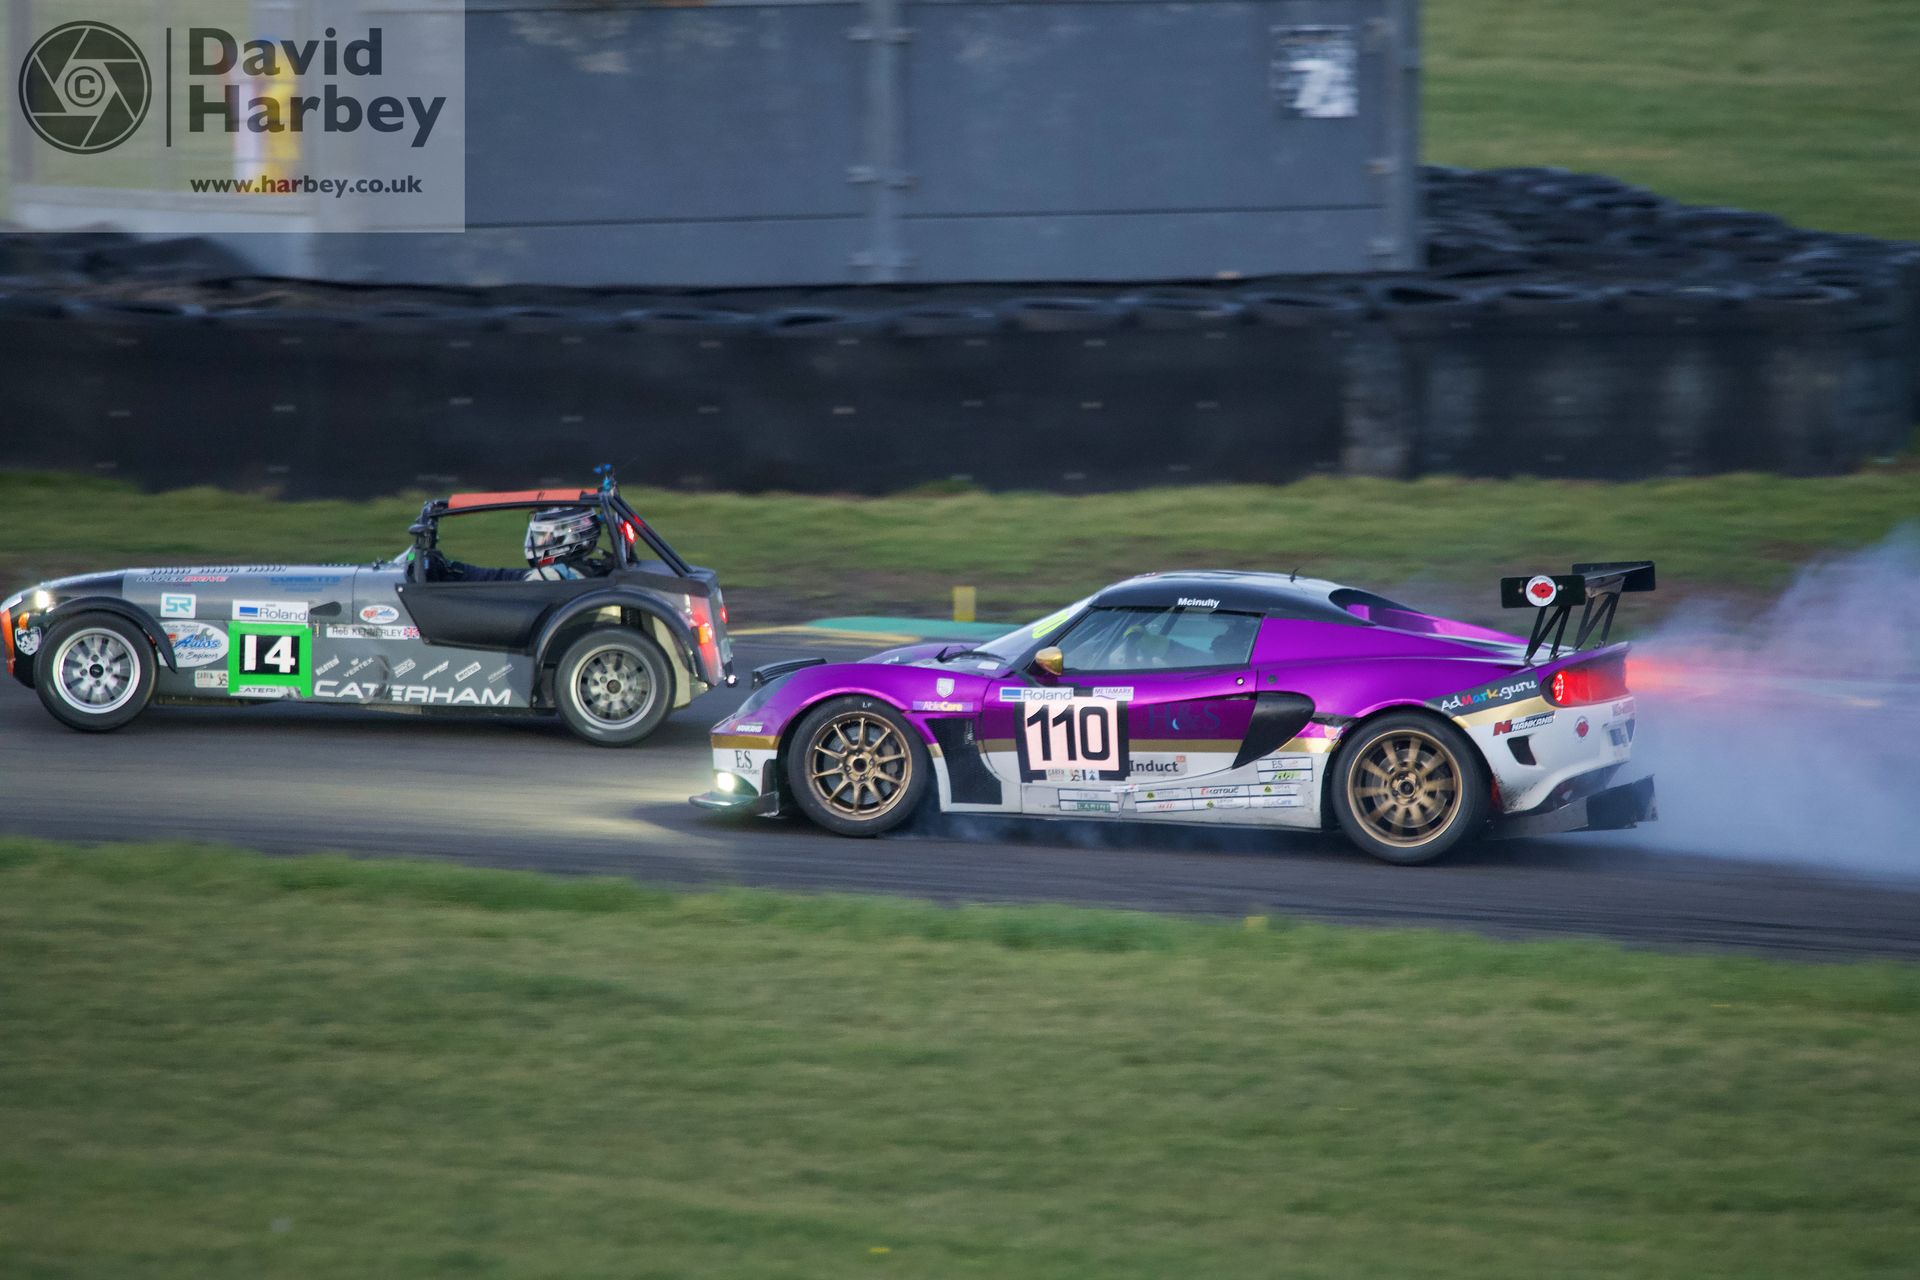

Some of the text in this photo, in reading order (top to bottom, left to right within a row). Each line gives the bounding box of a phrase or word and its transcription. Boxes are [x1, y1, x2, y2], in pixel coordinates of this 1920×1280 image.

[260, 606, 307, 621] Roland
[244, 634, 296, 673] 14
[343, 657, 374, 677] VERTEX
[313, 680, 512, 705] CATERHAM
[1023, 689, 1073, 701] Roland
[1441, 680, 1537, 711] AdMark.guru
[1027, 704, 1110, 761] 110
[735, 749, 753, 769] ES
[1130, 759, 1179, 773] Induct
